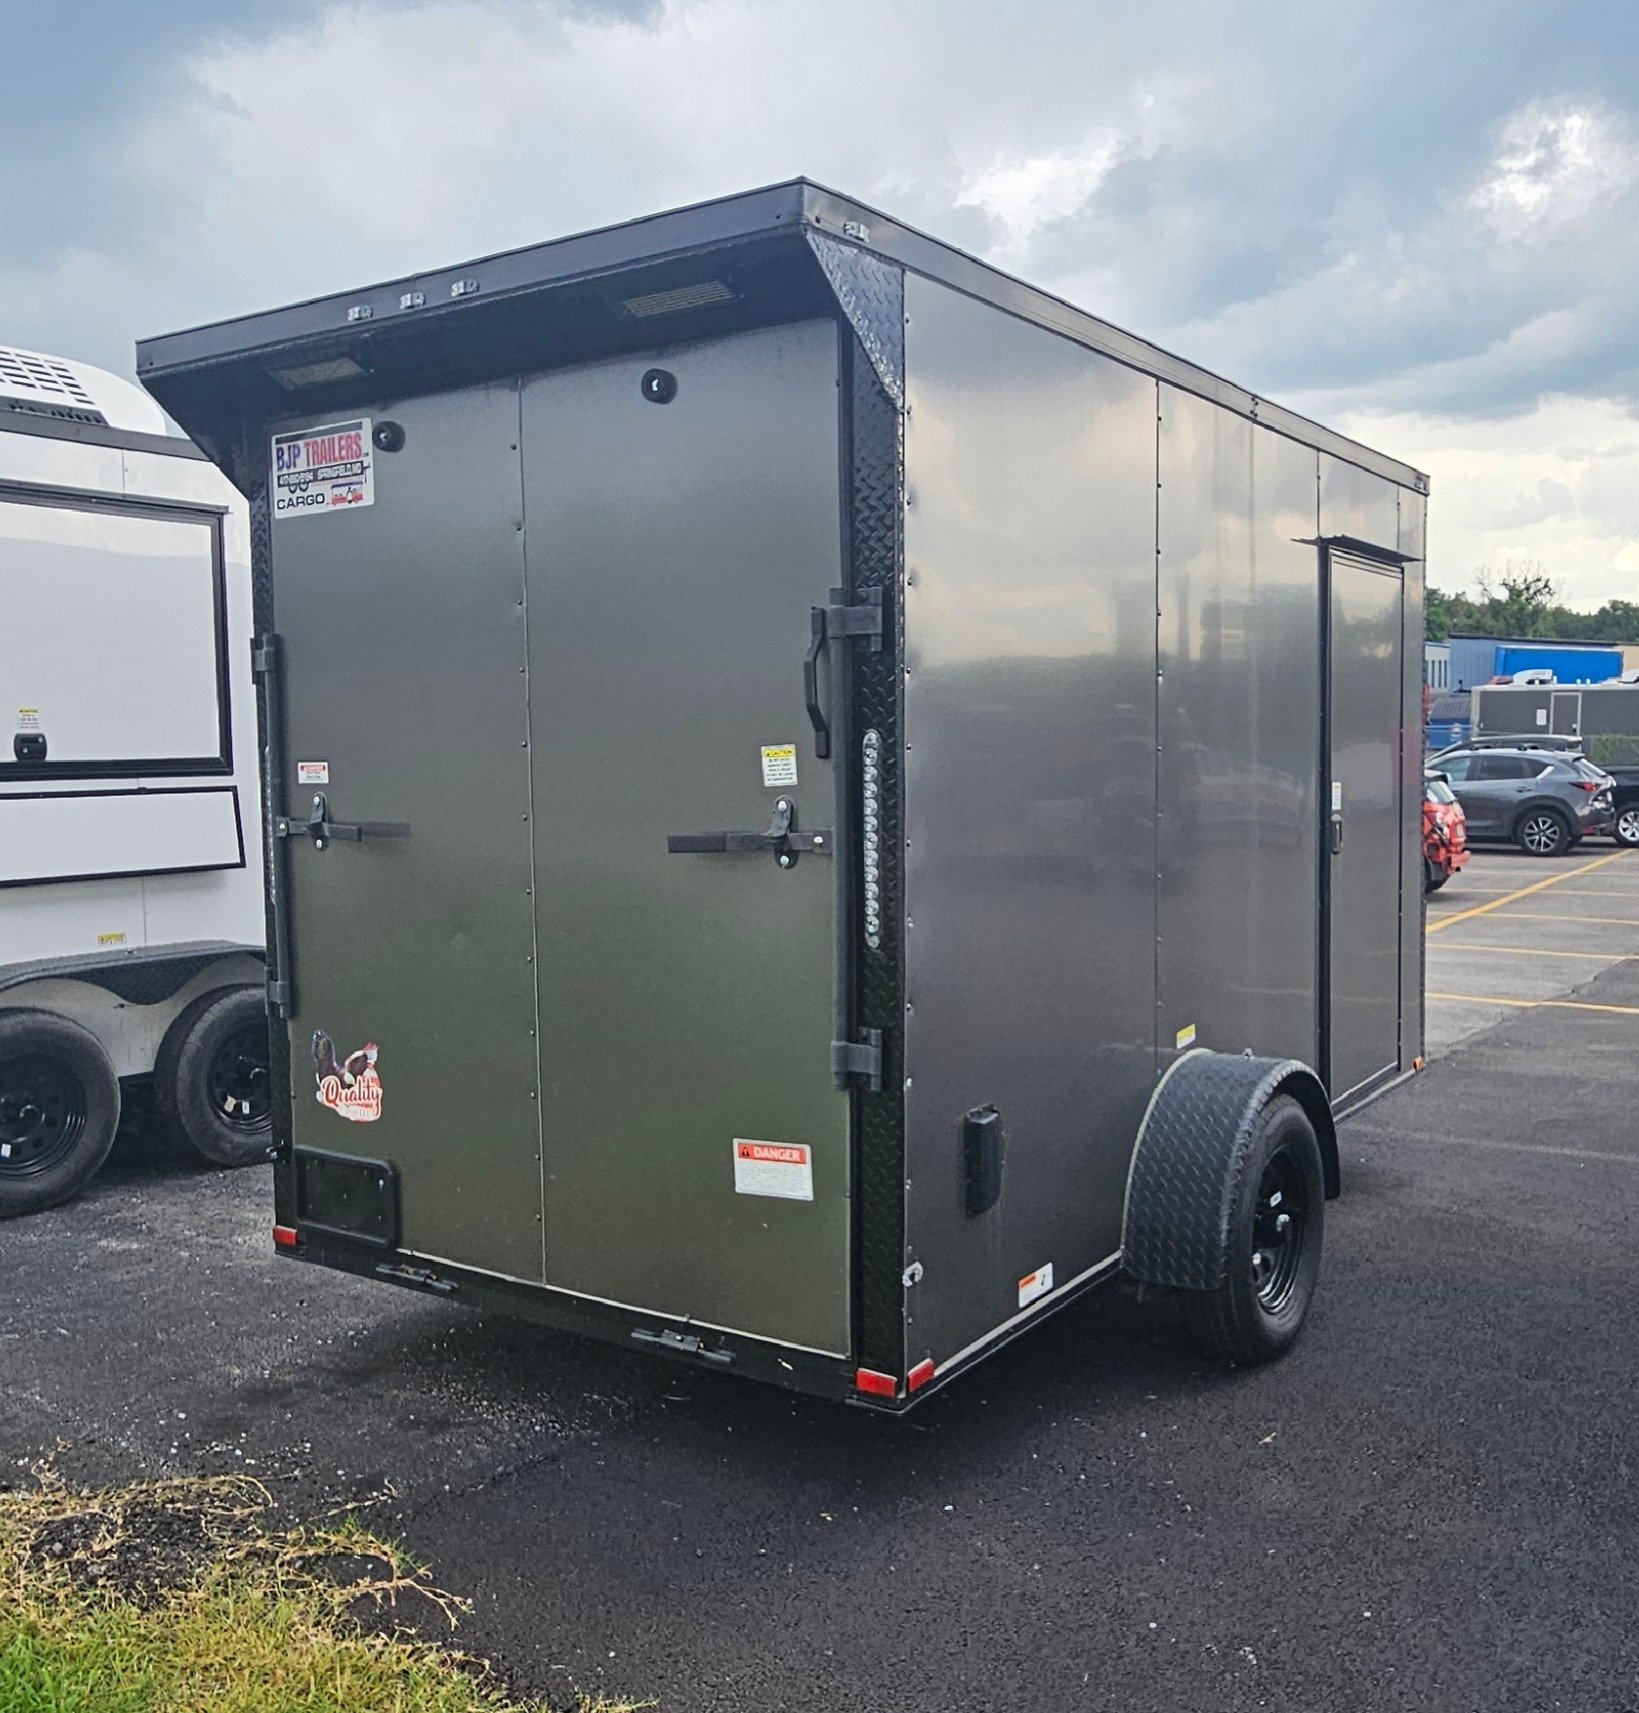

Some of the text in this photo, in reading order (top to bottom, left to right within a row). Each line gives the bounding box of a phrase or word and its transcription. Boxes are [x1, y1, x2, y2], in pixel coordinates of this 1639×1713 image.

[276, 433, 362, 472] BJP TRAILERS
[277, 494, 325, 510] CARGO
[322, 1078, 380, 1117] Quality
[753, 1146, 801, 1162] DANGER
